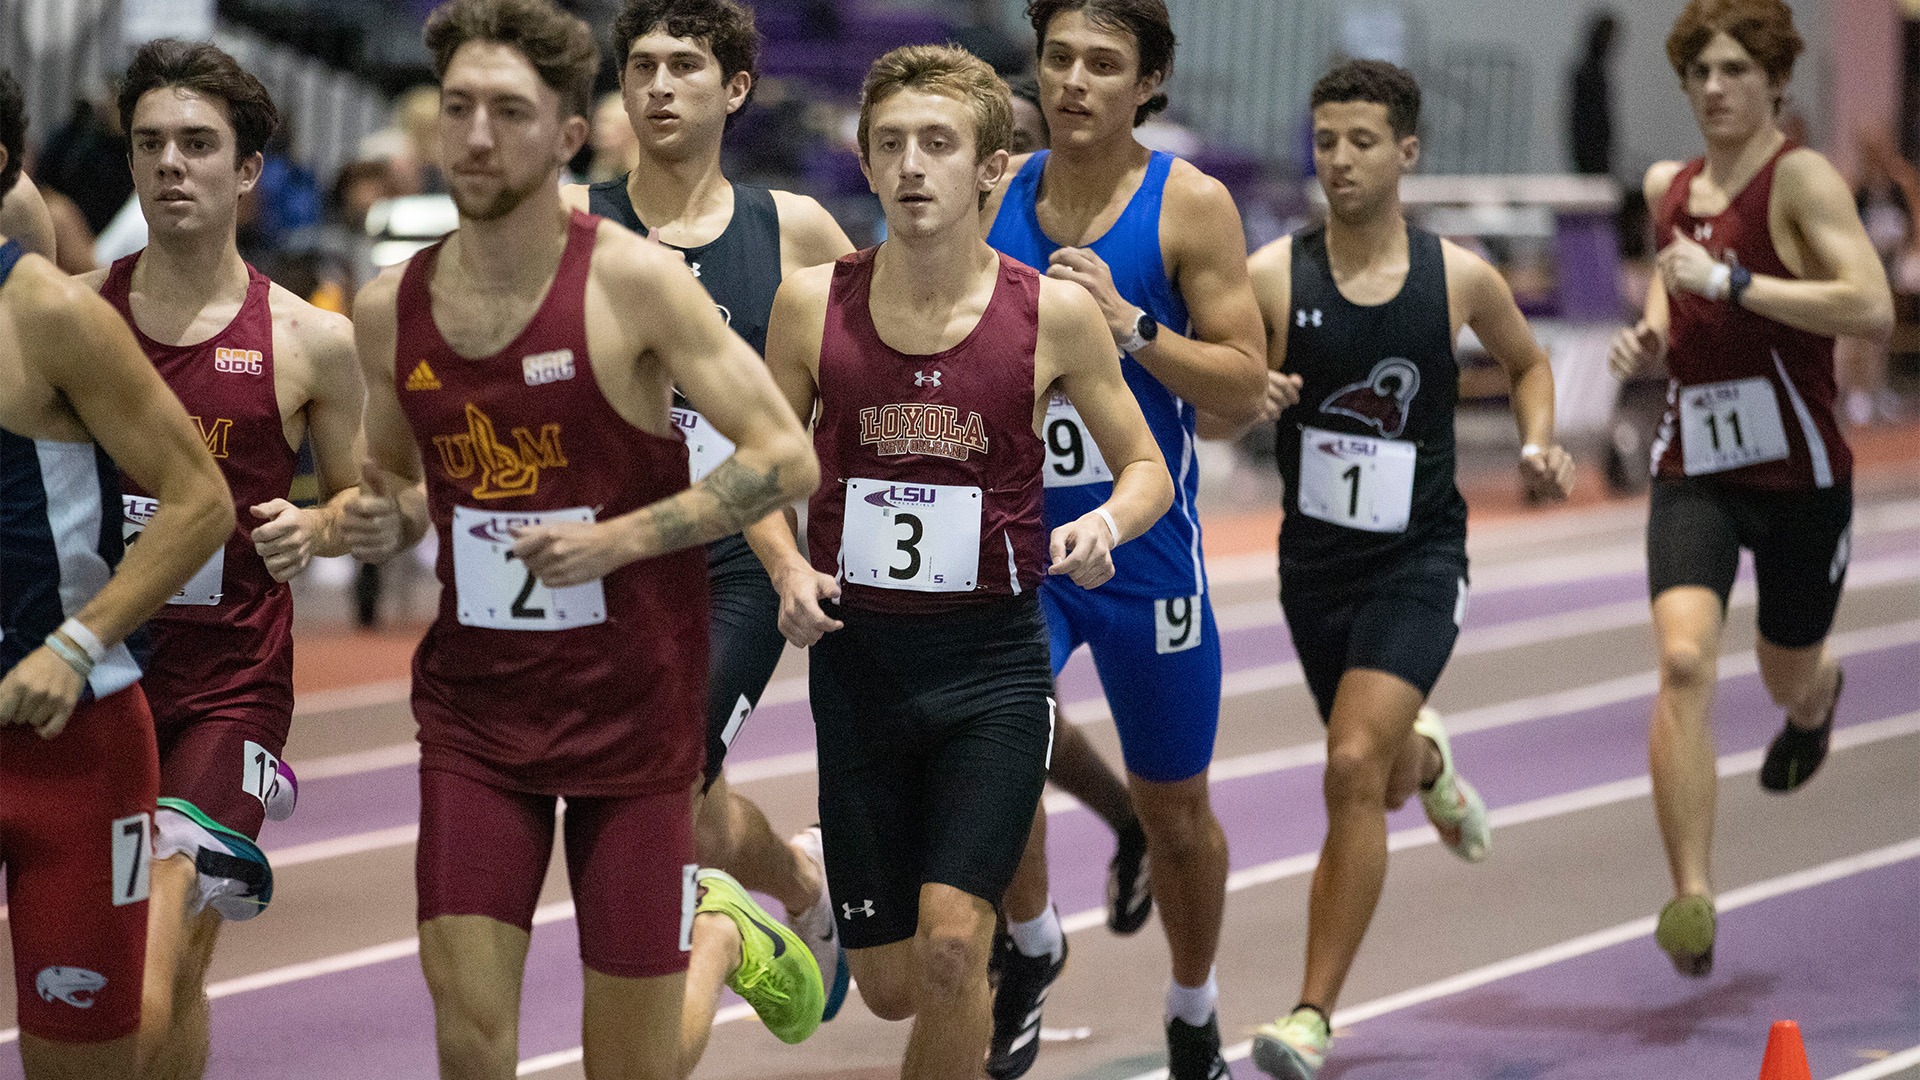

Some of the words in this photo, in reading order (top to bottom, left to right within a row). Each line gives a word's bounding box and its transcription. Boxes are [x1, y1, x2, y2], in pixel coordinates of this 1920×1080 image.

[215, 347, 263, 375] SBC
[671, 411, 698, 429] SU
[860, 403, 988, 454] LOYOLA
[1705, 411, 1743, 450] 11
[877, 439, 908, 456] NEW
[909, 439, 969, 461] ORLEANS
[1048, 418, 1085, 477] 9
[130, 499, 157, 517] LS
[889, 485, 936, 504] LSU
[1343, 465, 1361, 517] 1
[888, 513, 923, 580] 3
[1165, 597, 1192, 648] 9
[255, 752, 278, 806] 12
[123, 821, 143, 897] 7
